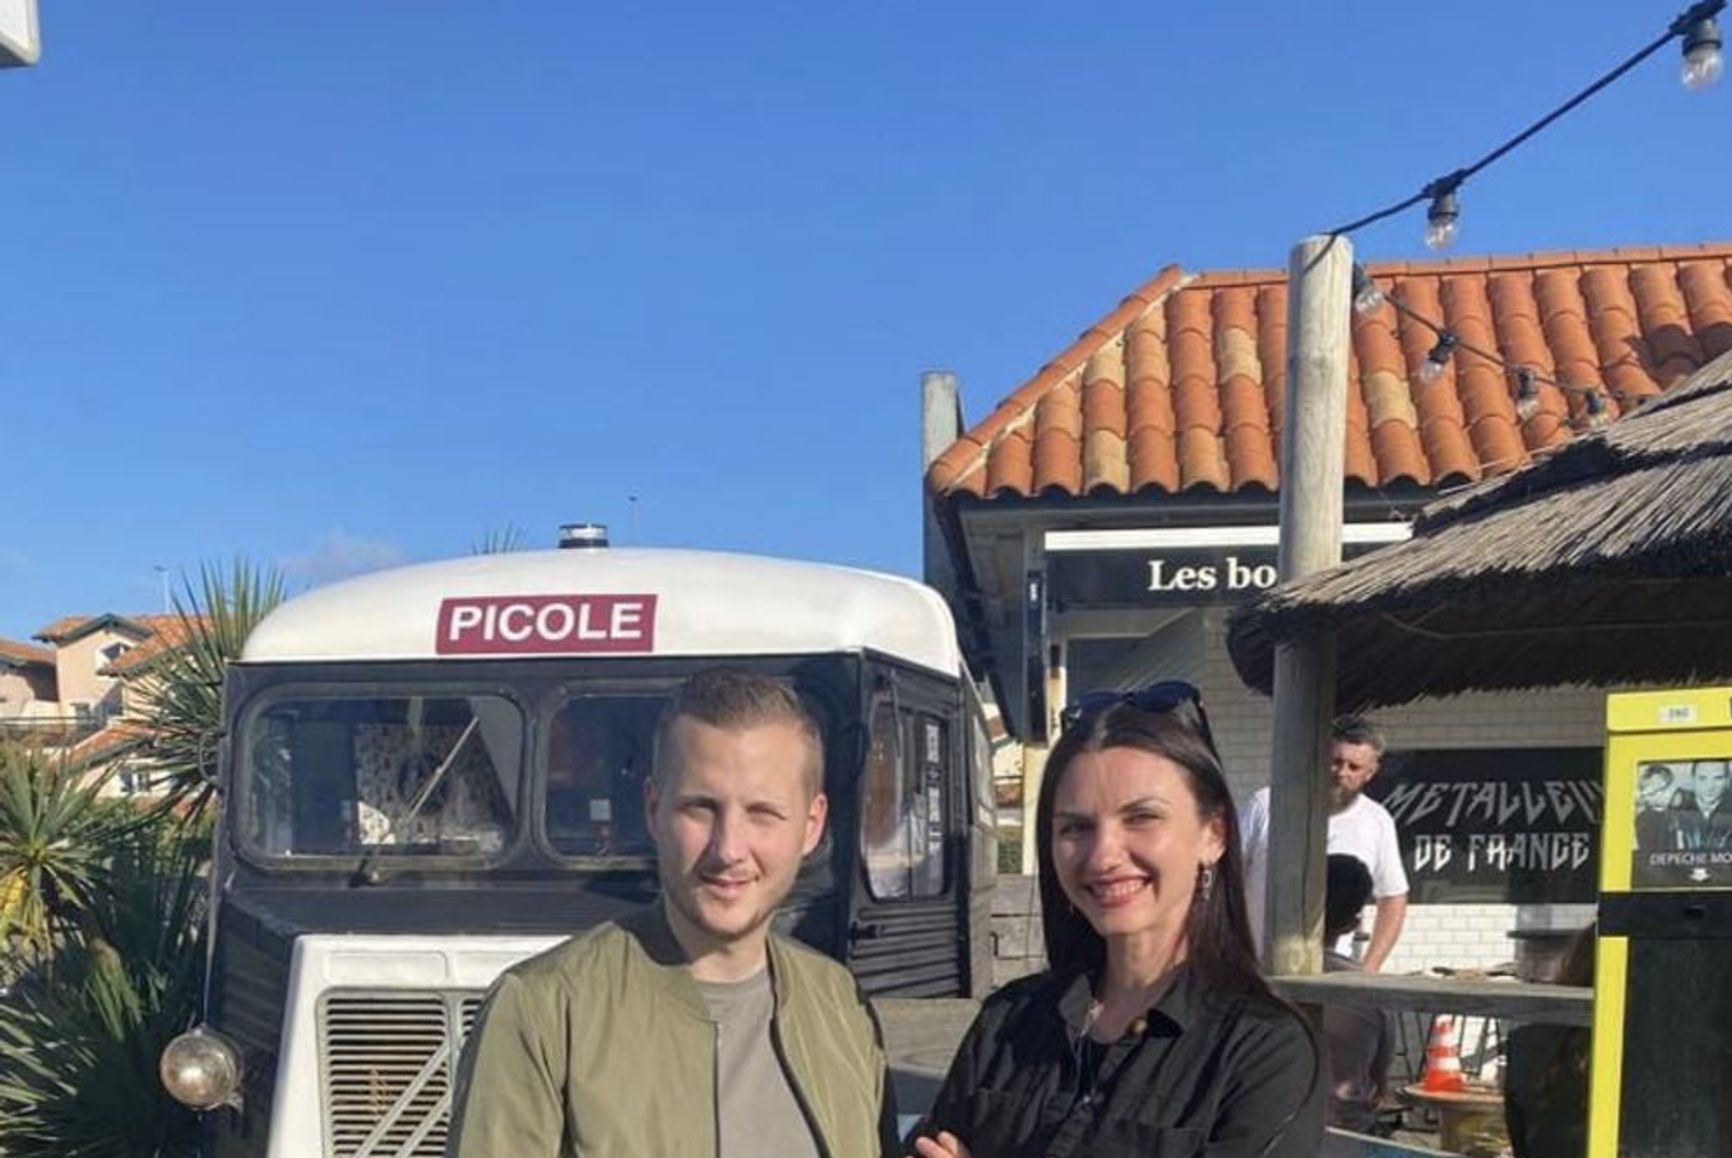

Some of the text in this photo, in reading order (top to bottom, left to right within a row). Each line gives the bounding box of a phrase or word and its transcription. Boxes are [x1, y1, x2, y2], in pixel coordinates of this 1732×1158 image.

[1148, 559, 1217, 591] Les
[449, 603, 643, 641] PICOLE
[1415, 834, 1451, 872] DE
